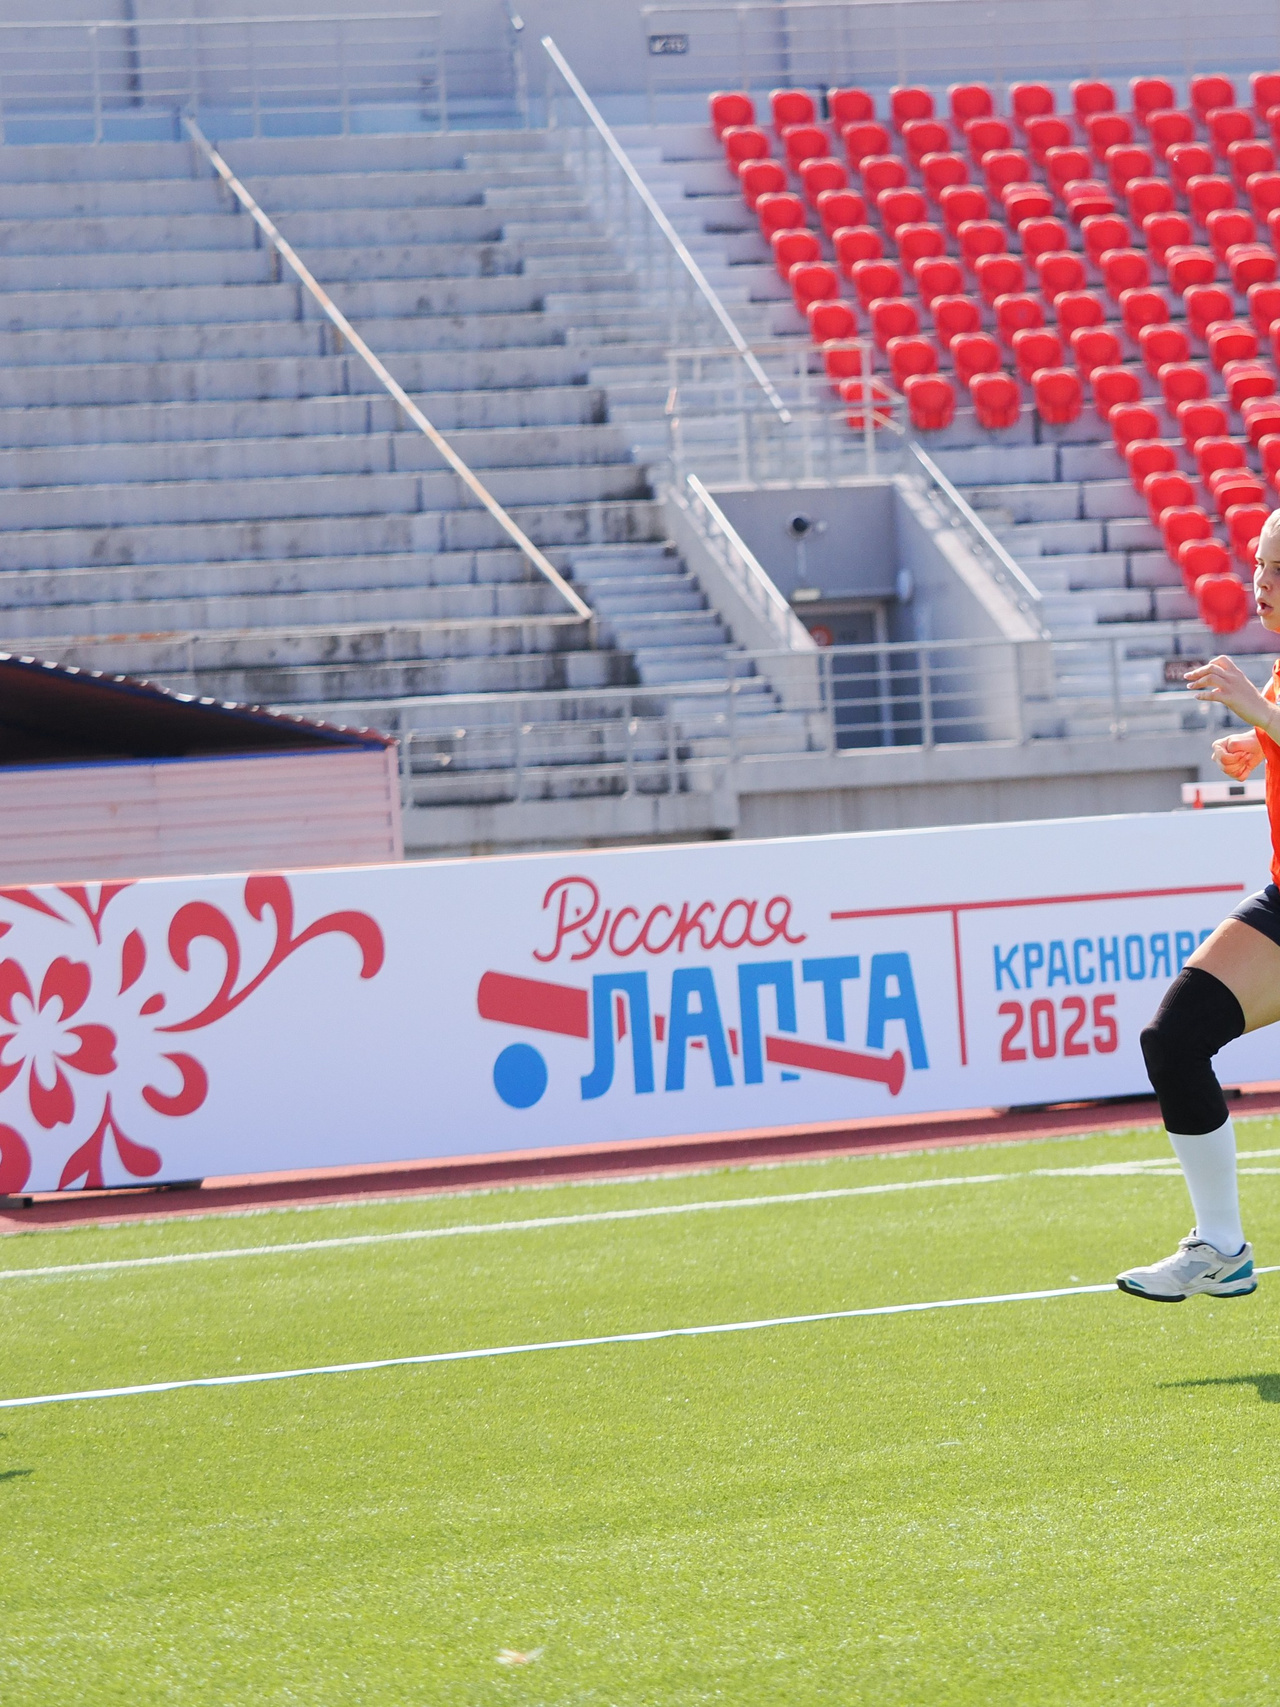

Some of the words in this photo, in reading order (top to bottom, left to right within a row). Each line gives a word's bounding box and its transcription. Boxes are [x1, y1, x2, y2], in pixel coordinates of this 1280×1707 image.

[532, 875, 807, 963] Русская
[993, 929, 1214, 991] КРАСНОЯР
[580, 951, 930, 1102] ЛАПТА
[998, 993, 1119, 1063] 2025
